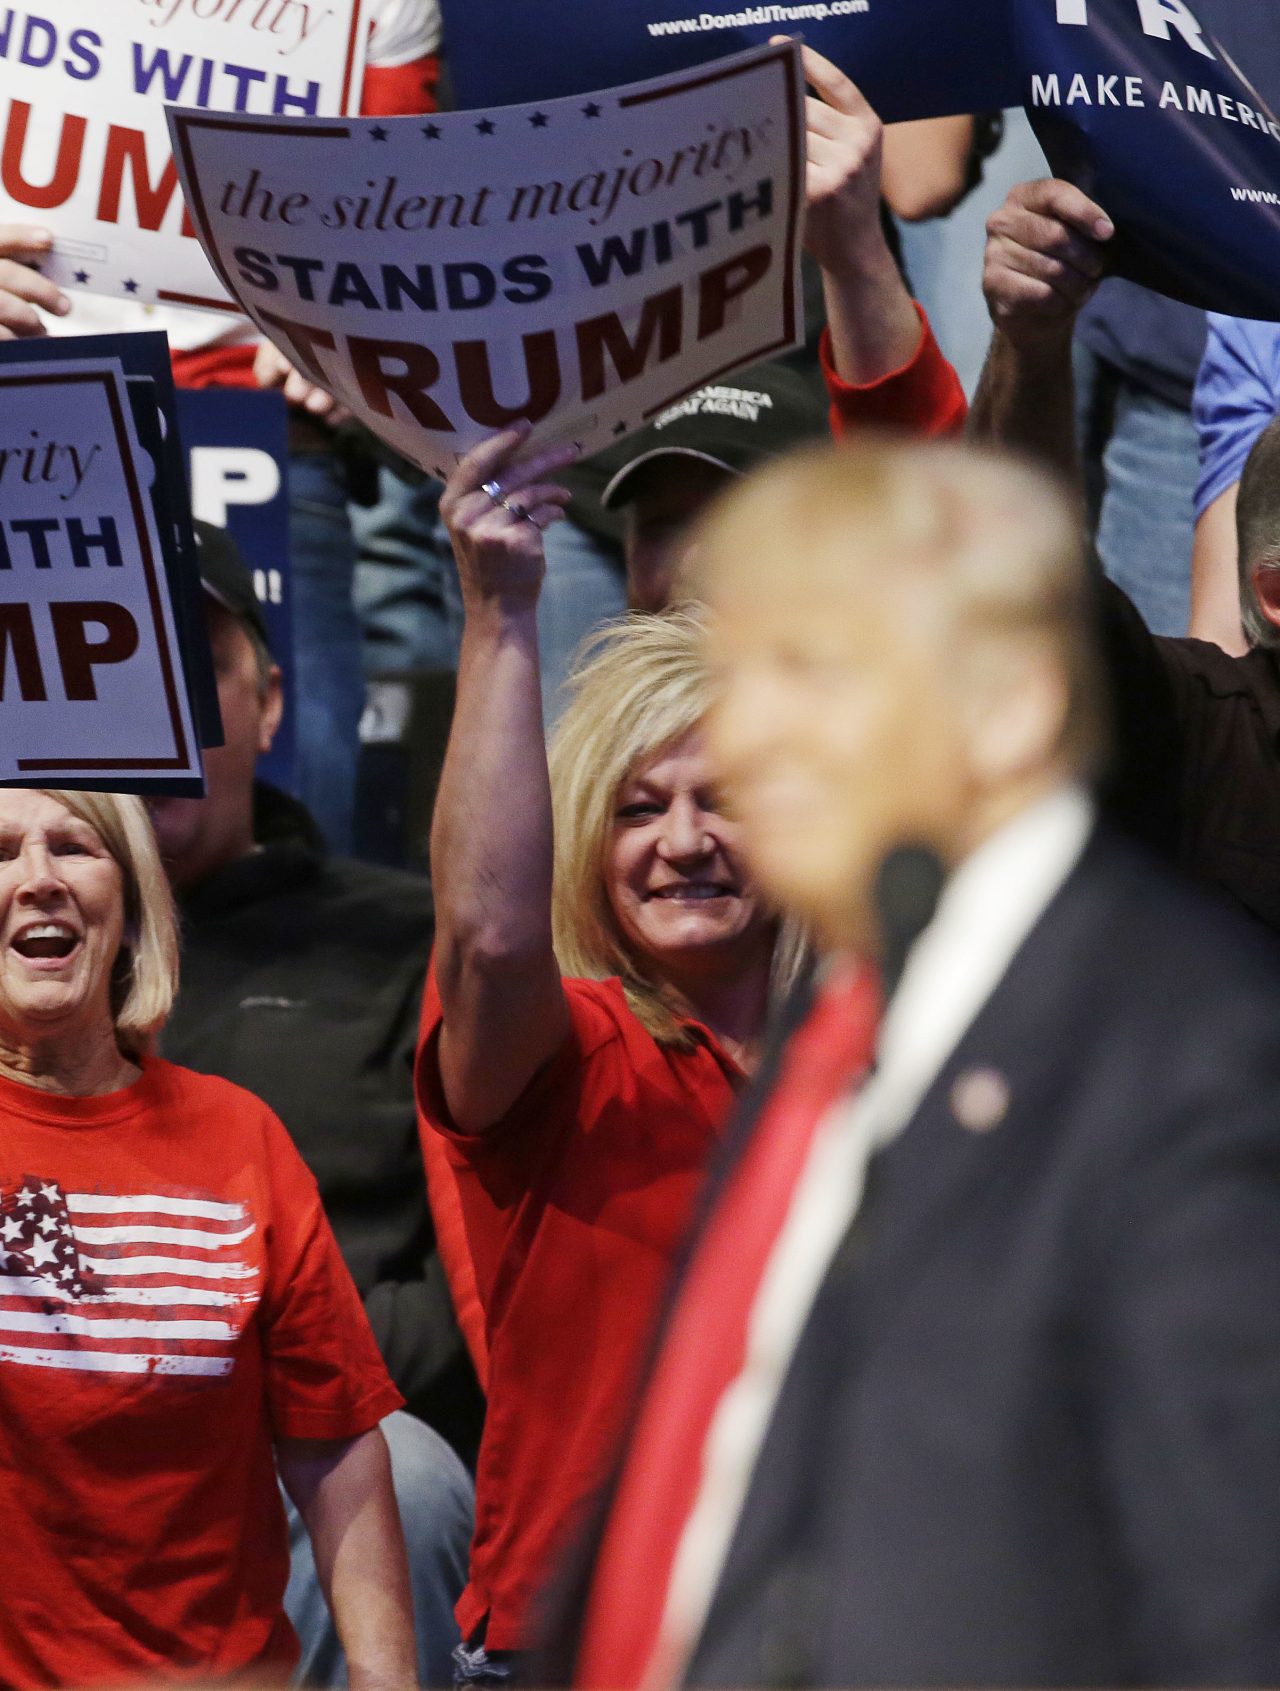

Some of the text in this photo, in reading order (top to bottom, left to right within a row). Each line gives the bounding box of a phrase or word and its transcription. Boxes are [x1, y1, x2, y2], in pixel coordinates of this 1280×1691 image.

[646, 0, 870, 37] www.DonaldJTrump.com
[131, 41, 321, 117] WITH
[1030, 73, 1146, 108] MAKE
[219, 114, 777, 232] the silent majority
[232, 177, 775, 313] STANDS WITH
[253, 242, 775, 433] TRUMP
